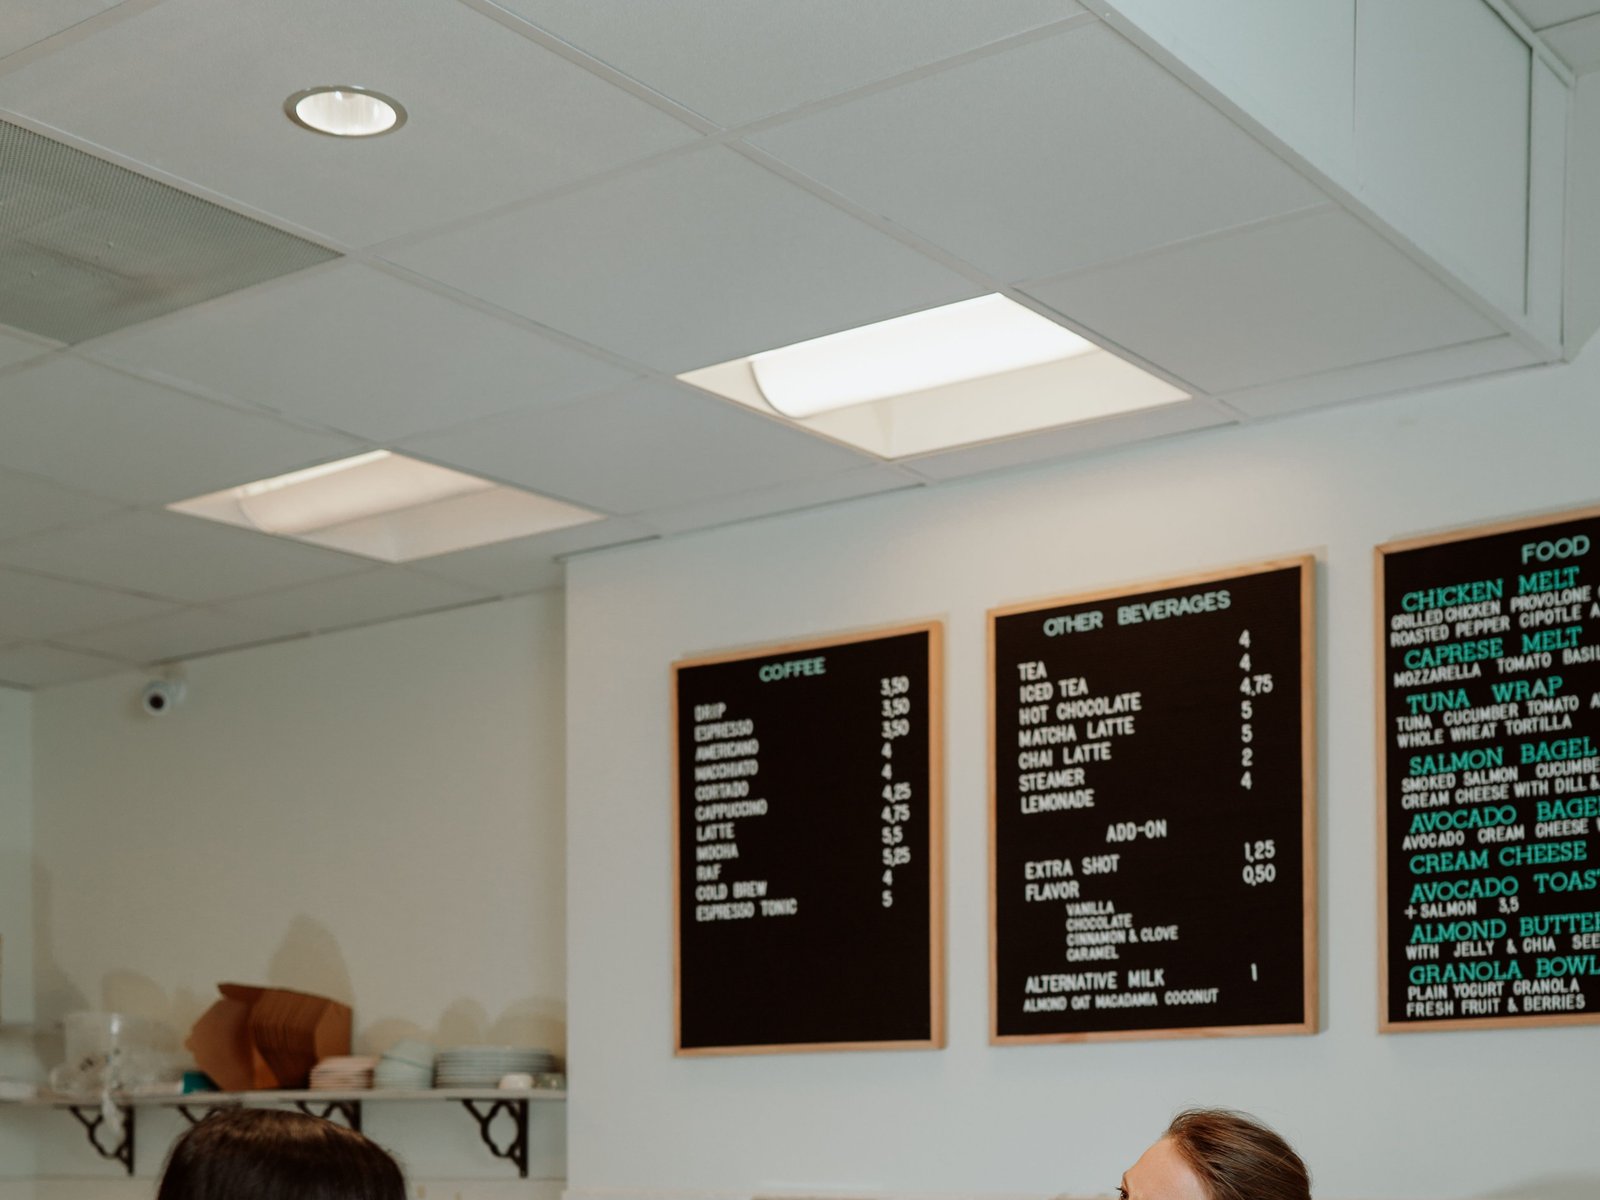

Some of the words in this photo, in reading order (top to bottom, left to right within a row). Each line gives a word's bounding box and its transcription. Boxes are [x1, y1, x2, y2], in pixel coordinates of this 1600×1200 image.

[1522, 535, 1589, 563] FOOD
[1402, 579, 1502, 611] CHICKEN
[1519, 566, 1579, 594] MELT
[1043, 611, 1102, 636] OTHER
[1117, 590, 1230, 625] BEVERAGES
[1391, 608, 1443, 630] GRILLED
[1445, 600, 1500, 622] CHICKEN
[1510, 585, 1590, 612] PROVOLONE
[1390, 624, 1449, 647] ROASTED
[1455, 615, 1510, 637] PEPPER
[1519, 604, 1580, 628] CIPOTLE
[1017, 661, 1047, 680] TEA
[1239, 629, 1250, 647] 4
[1404, 638, 1503, 669] CAPRESE
[1522, 626, 1582, 653] MELT
[759, 657, 824, 681] COFFEE
[1020, 681, 1053, 703] ICED
[1058, 677, 1088, 697] TEA
[1239, 653, 1251, 671] 4
[1394, 662, 1481, 687] MOZZARELLA
[1497, 651, 1551, 673] TOMATO
[1019, 704, 1049, 725] HOT
[1056, 692, 1141, 720] CHOCOLATE
[1406, 689, 1470, 714] TUNA
[1492, 676, 1562, 702] WRAP
[1018, 724, 1076, 747] MATCHA
[1087, 715, 1135, 739] LATTE
[1241, 700, 1252, 719] 5
[1396, 714, 1432, 731] TUNA
[1443, 703, 1518, 726] CUCUMBER
[1527, 695, 1578, 715] TOMATO
[1590, 693, 1600, 708] A
[694, 719, 753, 741] ESPRESSO
[1397, 728, 1443, 748] WHOLE
[1450, 722, 1497, 741] WHEAT
[1505, 714, 1571, 734] TORTILLA
[881, 742, 891, 758] 4
[1018, 749, 1052, 769] CHAI
[1063, 741, 1111, 764] LATTE
[1241, 724, 1252, 742] 5
[1410, 746, 1502, 775] SALMON
[1521, 736, 1597, 763] BAGEL
[881, 763, 892, 779] 4
[1019, 767, 1084, 792] STEAMER
[1242, 747, 1252, 766] 2
[1402, 772, 1455, 793] SMOKED
[1463, 766, 1518, 786] SALMON
[1021, 788, 1094, 814] LEMONADE
[1241, 771, 1251, 789] 4
[1402, 790, 1449, 809] CREAM
[1455, 783, 1508, 804] CHEESE
[1514, 780, 1548, 797] WITH
[1555, 776, 1587, 793] DILL
[1590, 774, 1600, 790] &
[696, 822, 734, 841] LATTE
[1106, 819, 1166, 842] ADD-ON
[1410, 805, 1516, 833] AVOCADO
[1402, 830, 1464, 850] AVOCADO
[1477, 824, 1524, 843] CREAM
[1535, 818, 1588, 838] CHEESE
[696, 843, 738, 860] MOCHA
[1409, 849, 1488, 874] CREAM
[1499, 841, 1586, 866] CHEESE
[1025, 859, 1073, 879] EXTRA
[1082, 854, 1119, 875] SHOT
[696, 883, 727, 901] COLD
[733, 881, 767, 898] BREW
[882, 869, 892, 885] 4
[1025, 880, 1079, 901] FLAVOR
[1410, 876, 1518, 903] AVOCADO
[696, 902, 754, 921] ESPRESSO
[760, 898, 797, 916] TONIC
[882, 890, 892, 907] 5
[1066, 901, 1114, 916] VANILLA
[1420, 900, 1476, 918] SALMON
[1066, 913, 1132, 932] CHOCOLATE
[1066, 929, 1125, 946] CINNAMON
[1128, 928, 1138, 942] &
[1140, 925, 1178, 942] CLOVE
[1410, 919, 1506, 943] ALMOND
[1066, 945, 1119, 961] CARAMEL
[1406, 944, 1438, 960] WITH
[1453, 940, 1494, 957] JELLY
[1506, 938, 1516, 953] &
[1523, 936, 1555, 953] CHIA
[1025, 971, 1117, 993] ALTERNATIVE
[1128, 969, 1164, 988] MILK
[1251, 963, 1257, 981] 1
[1409, 960, 1522, 984] GRANOLA
[1023, 996, 1067, 1012] ALMOND
[1071, 995, 1091, 1009] OAT
[1095, 992, 1157, 1008] MACADAMIA
[1164, 988, 1218, 1005] COCONUT
[1408, 984, 1447, 1000] PLAIN
[1453, 981, 1504, 998] YOGURT
[1513, 978, 1579, 995] GRANOLA
[1406, 1000, 1453, 1016] FRESH
[1461, 998, 1500, 1014] FRUIT
[1508, 997, 1517, 1012] &
[1523, 994, 1585, 1011] BERRIES
